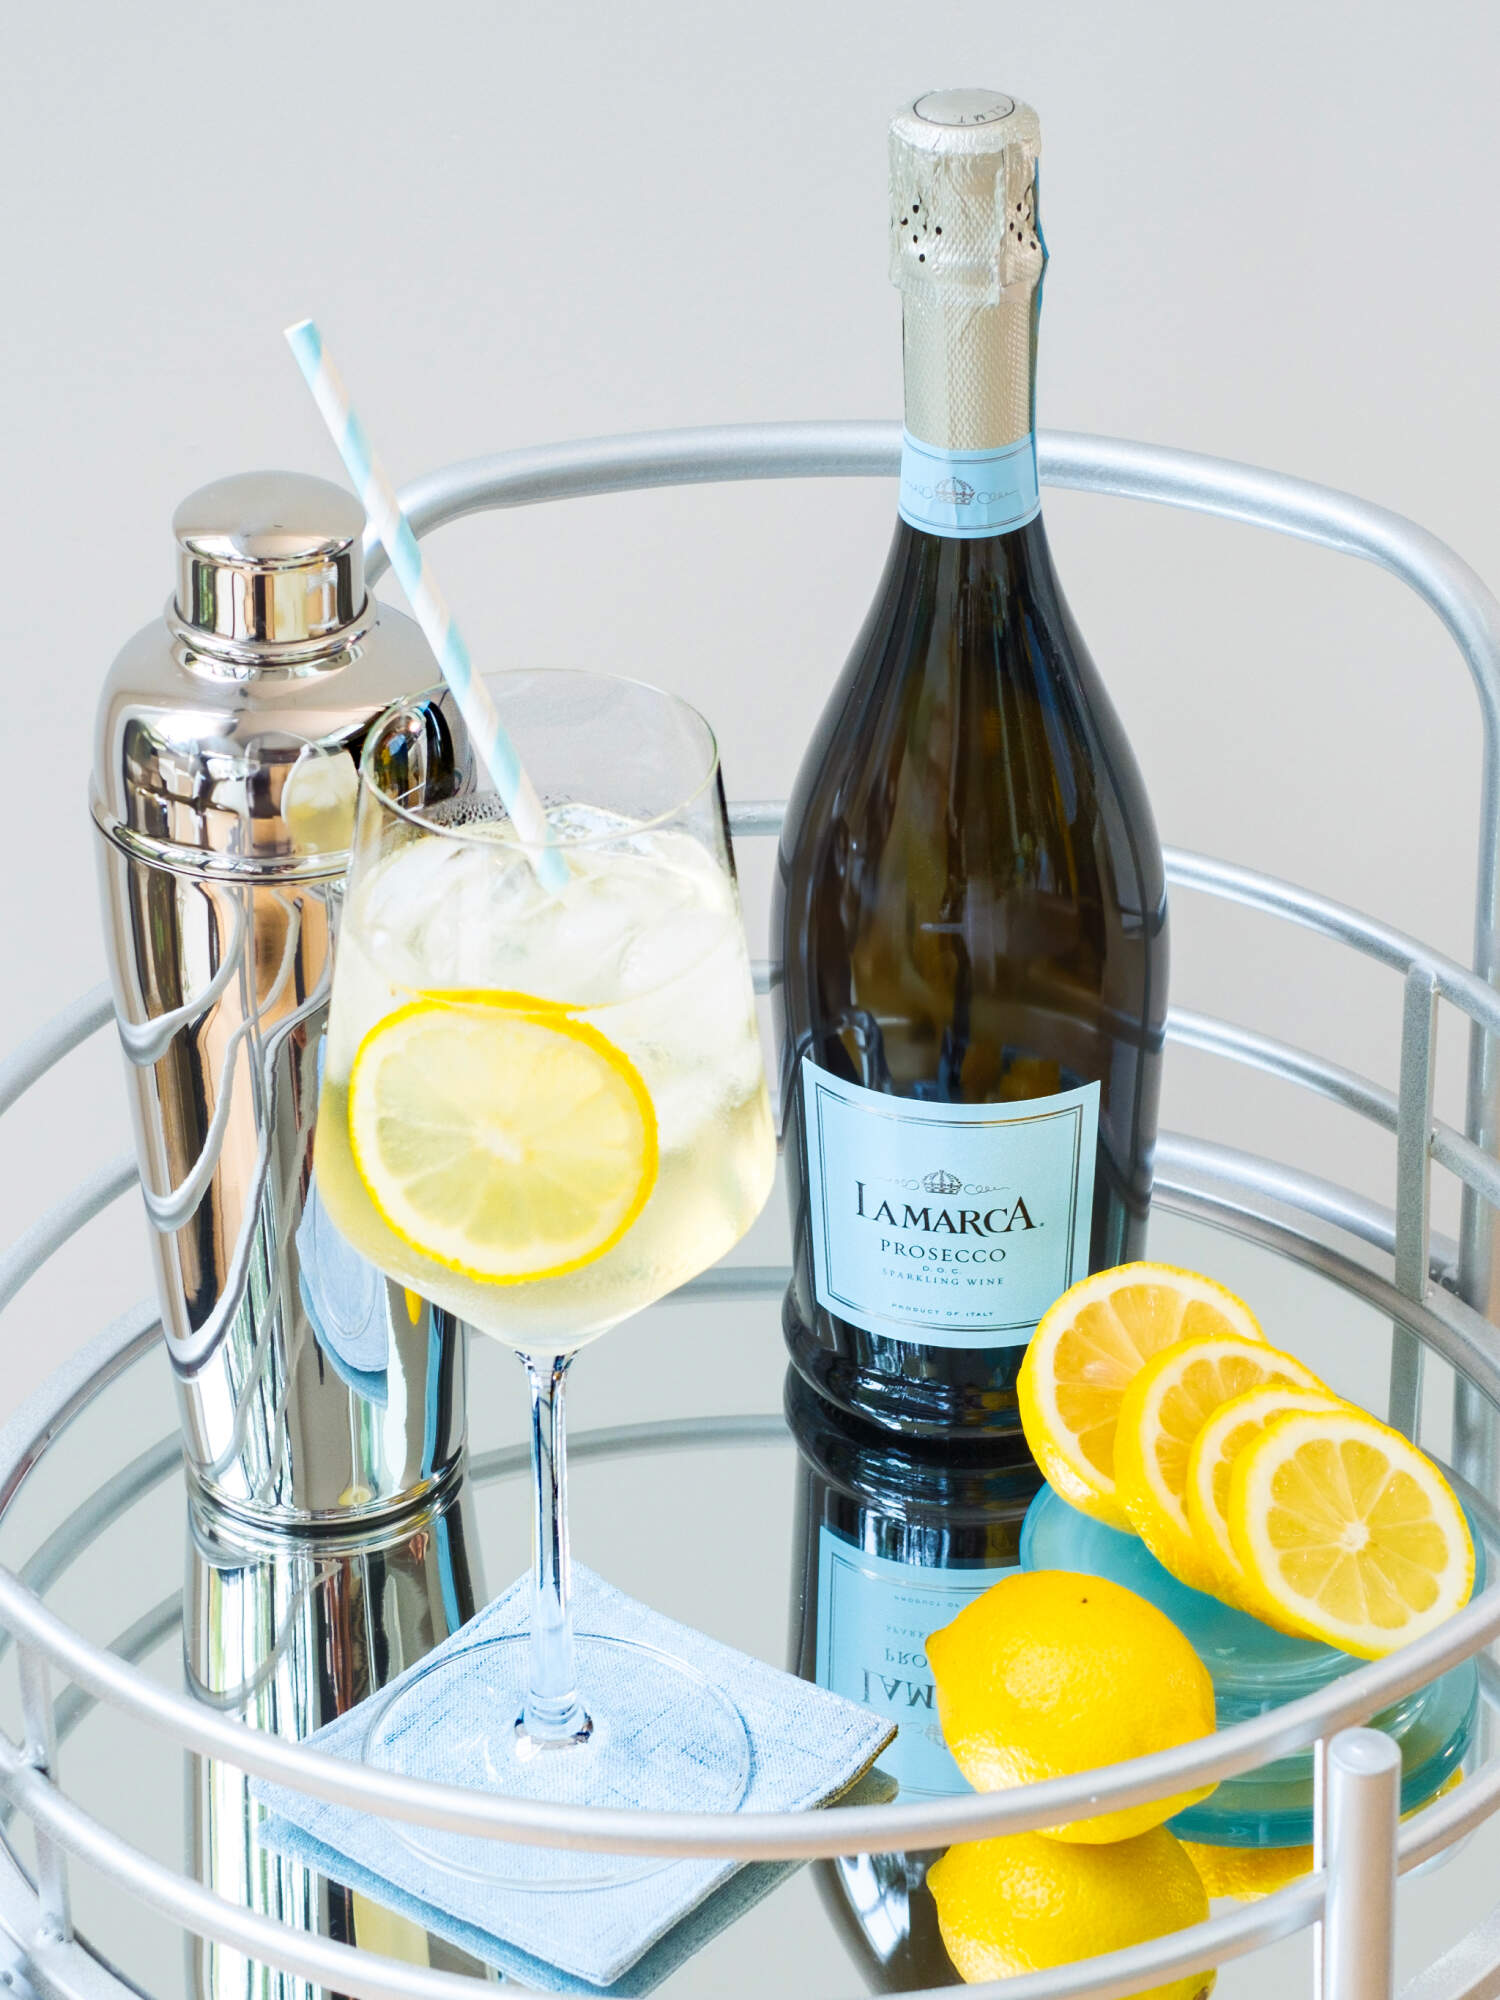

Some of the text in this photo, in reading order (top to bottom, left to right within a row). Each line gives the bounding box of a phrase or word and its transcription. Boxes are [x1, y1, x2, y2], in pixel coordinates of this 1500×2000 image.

[881, 1238, 1006, 1263] PROSECCO
[882, 1267, 1005, 1286] SPARKLING WINE
[891, 1303, 939, 1315] PRODUCT
